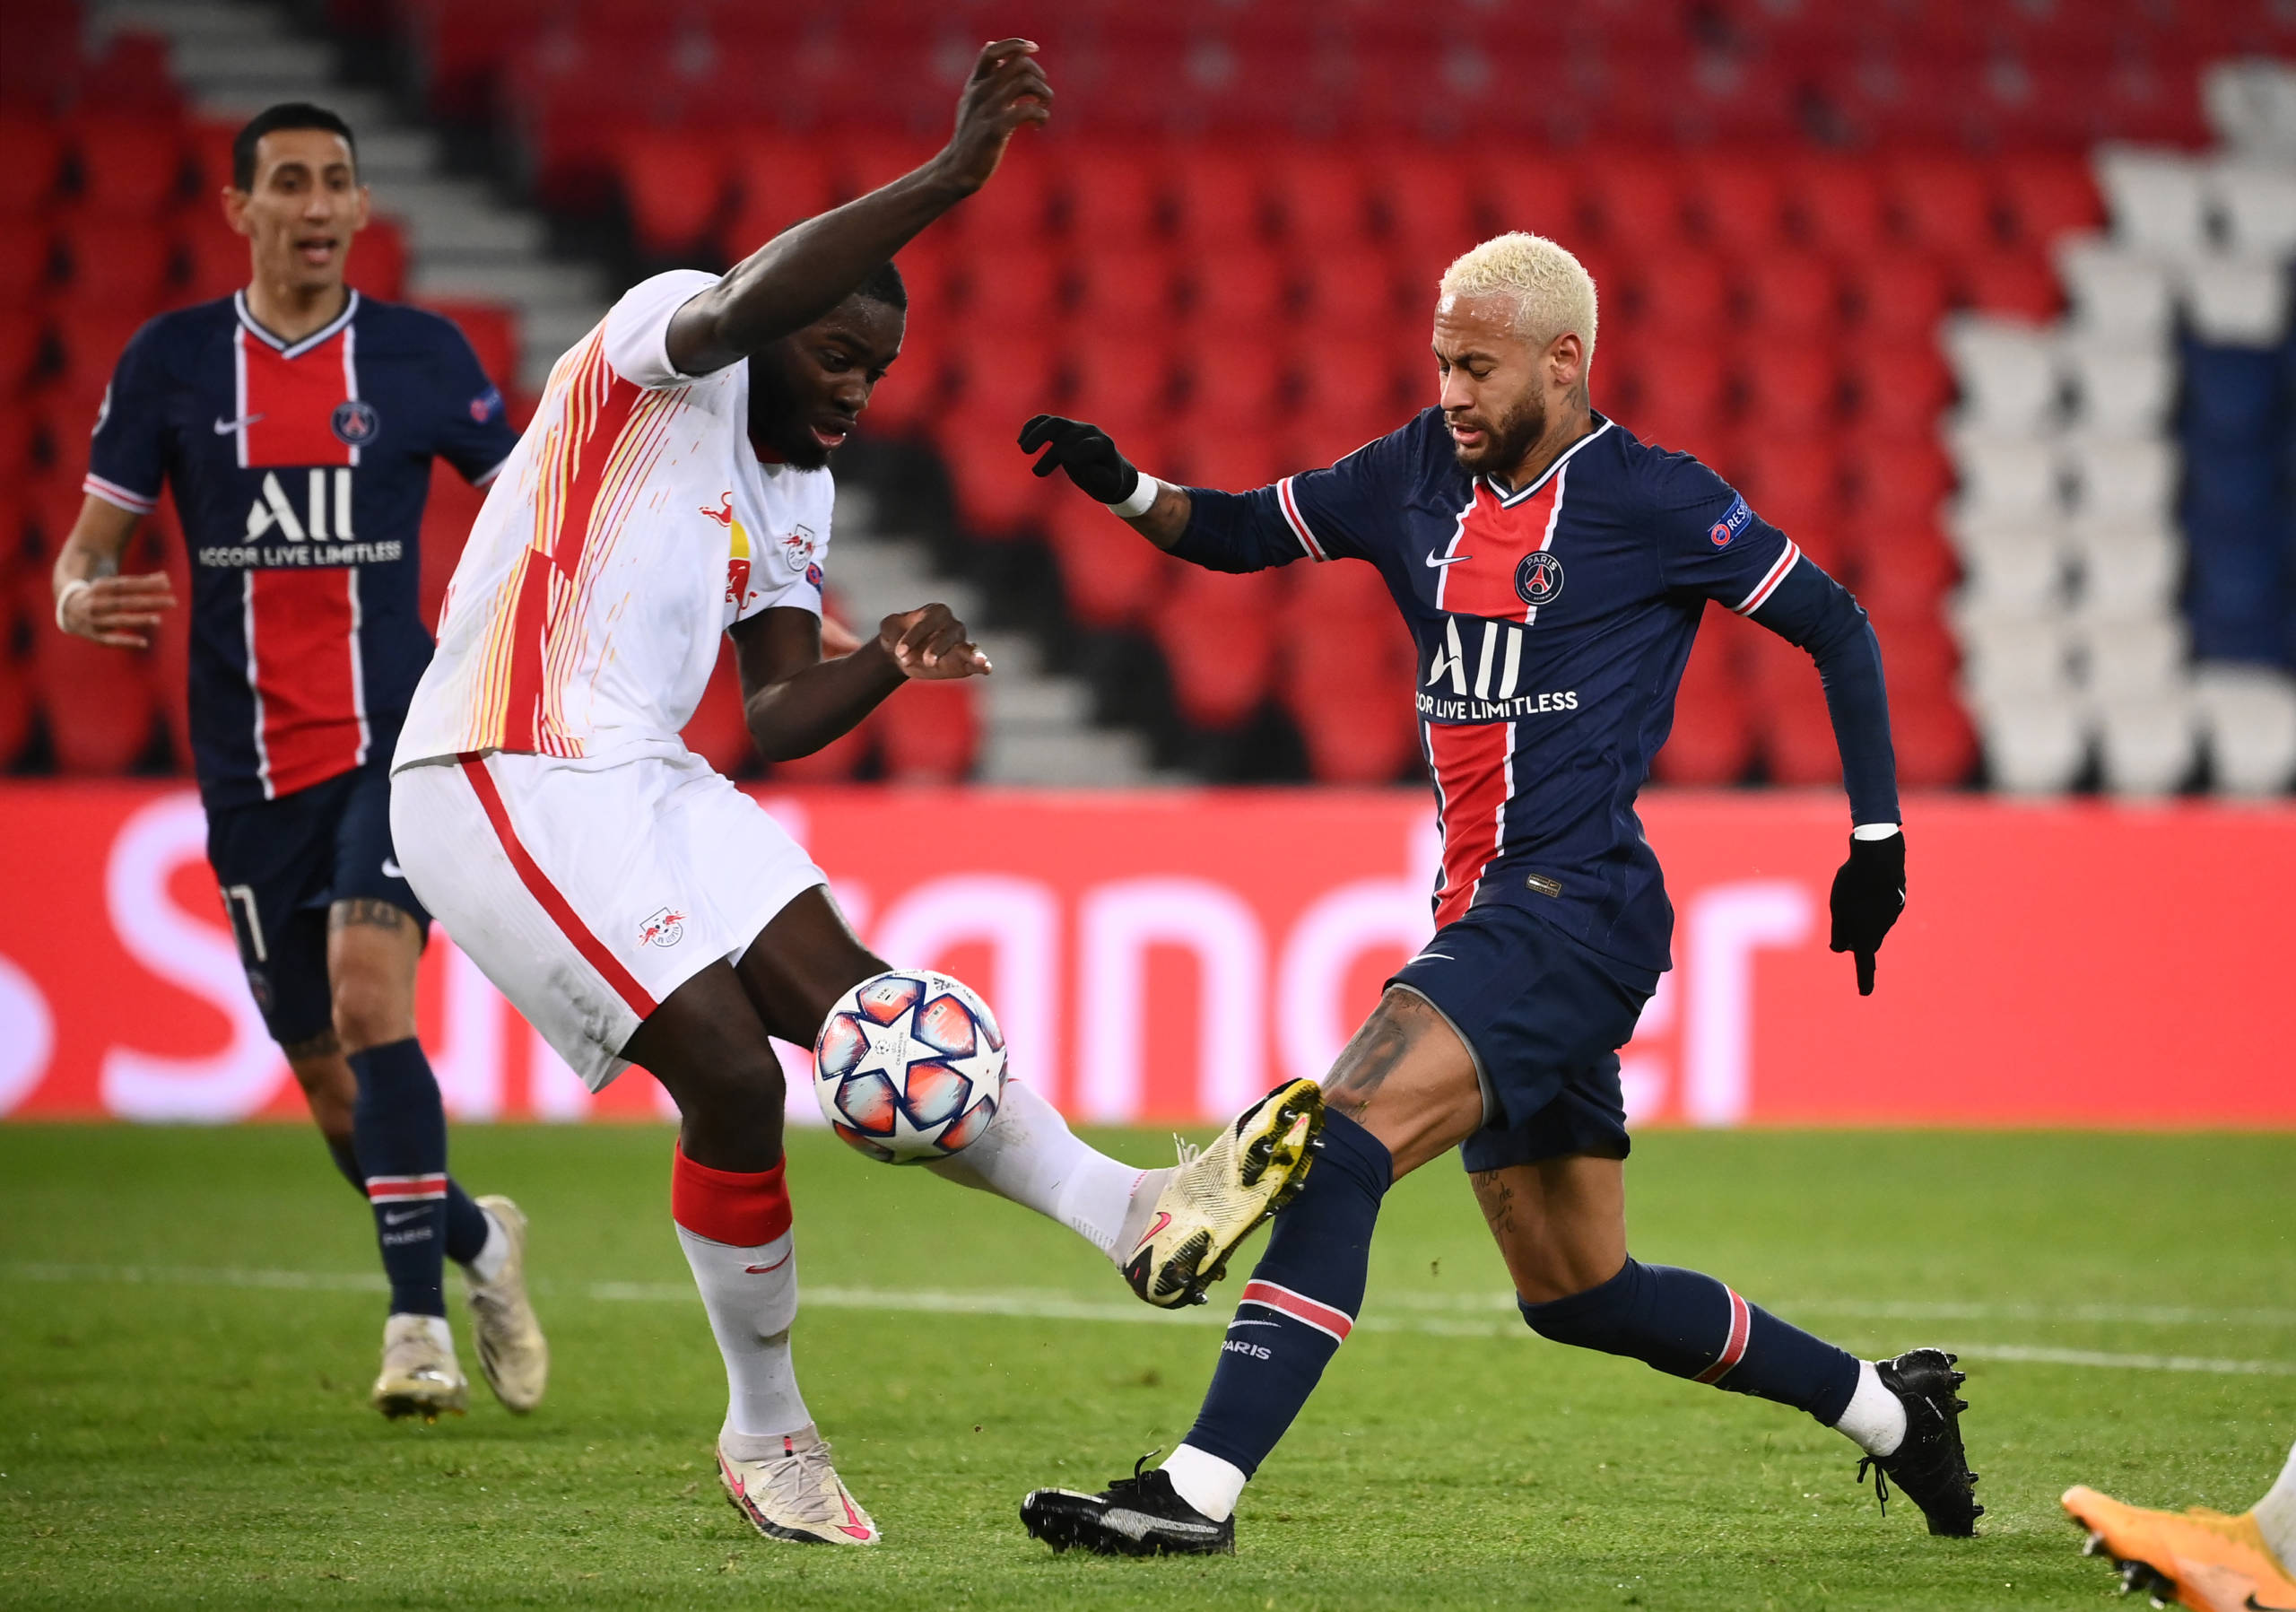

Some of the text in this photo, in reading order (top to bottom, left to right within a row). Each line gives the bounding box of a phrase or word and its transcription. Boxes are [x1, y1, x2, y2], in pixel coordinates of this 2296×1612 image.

[264, 545, 310, 566] LIVE
[314, 540, 403, 566] LIMITLESS
[1526, 555, 1557, 571] PARIS
[1436, 699, 1467, 719] LIVE
[1471, 691, 1578, 719] LIMITLESS
[1221, 1340, 1272, 1360] PARIS
